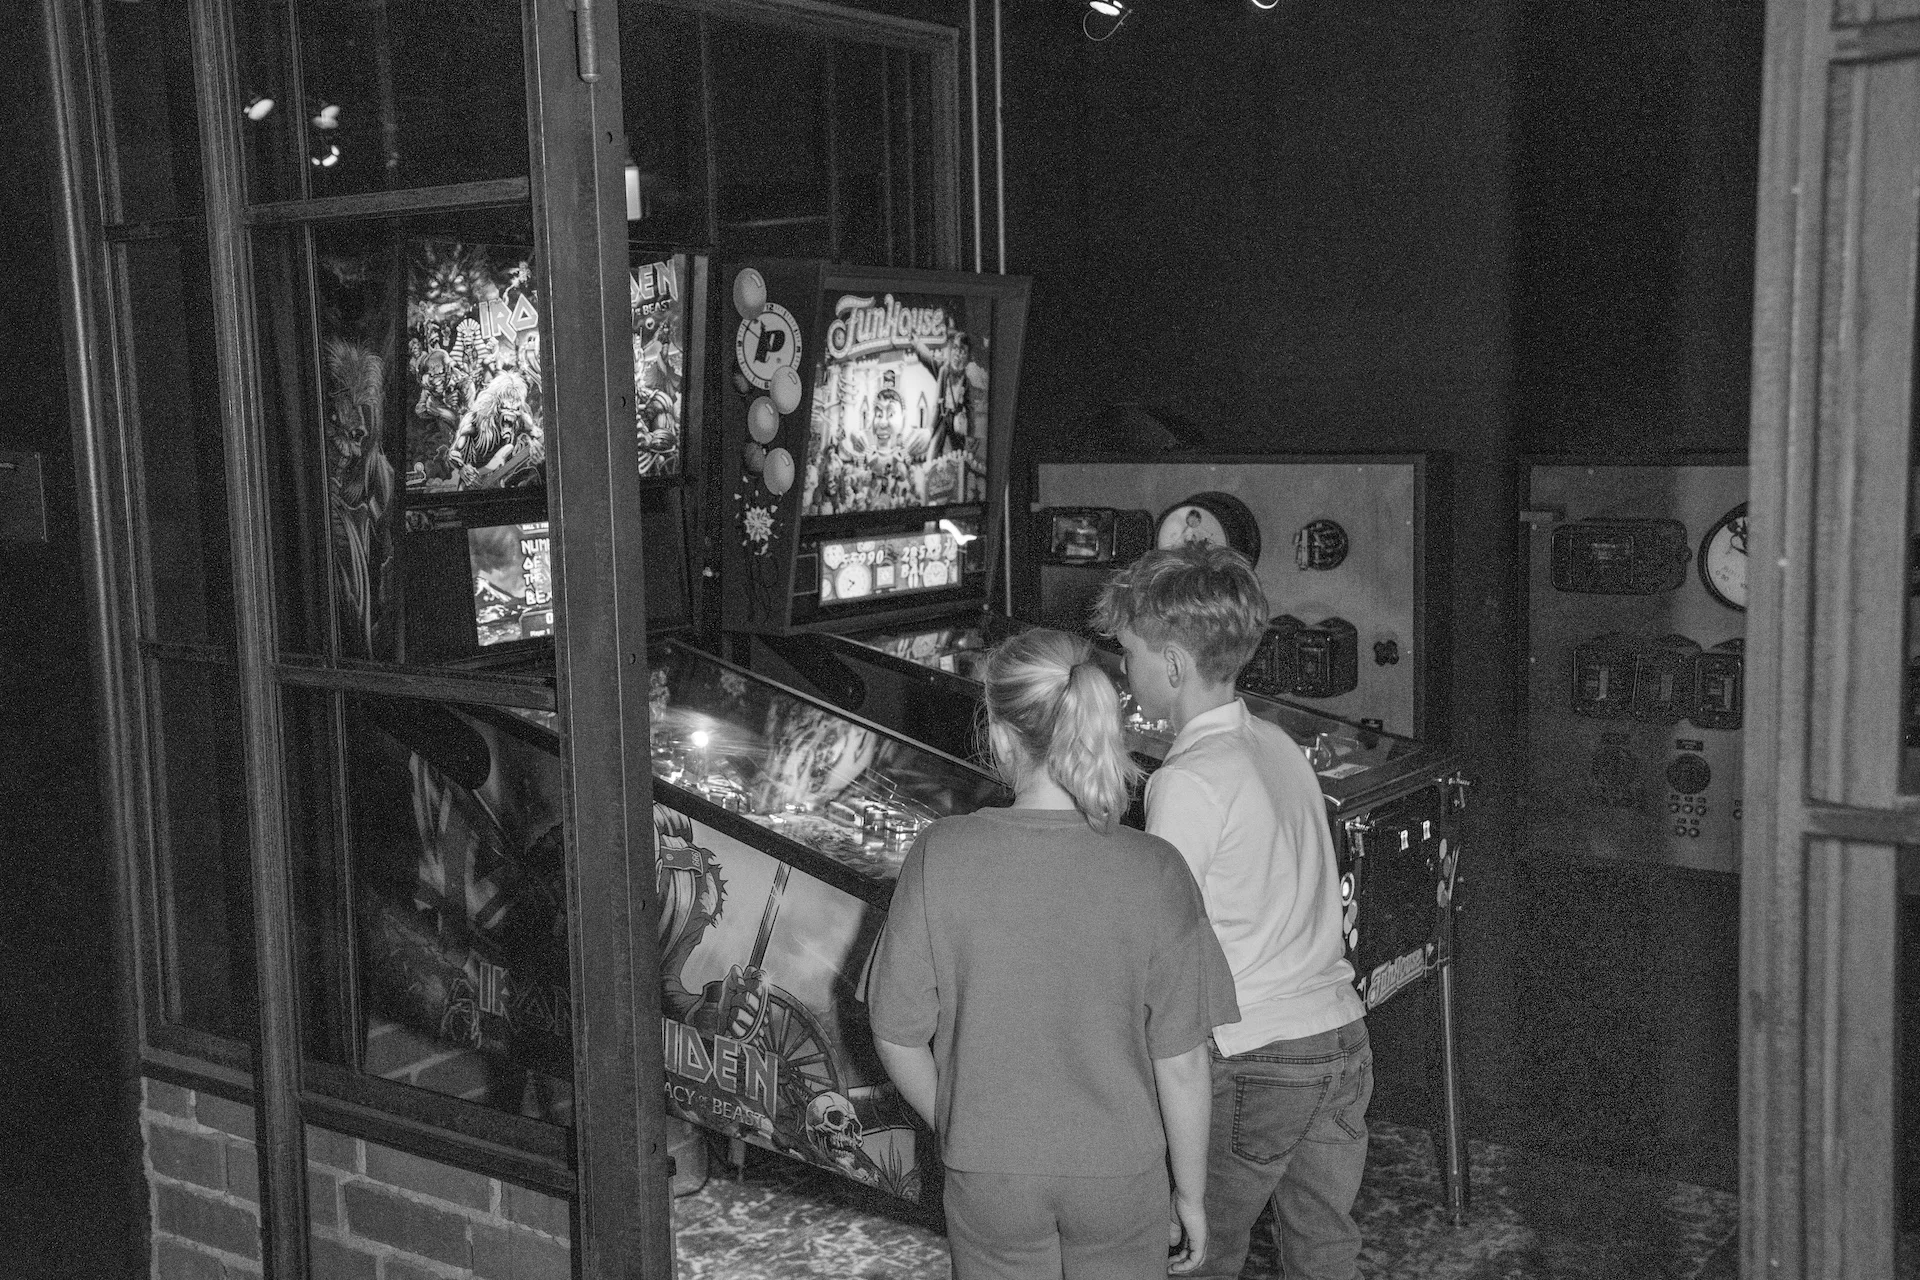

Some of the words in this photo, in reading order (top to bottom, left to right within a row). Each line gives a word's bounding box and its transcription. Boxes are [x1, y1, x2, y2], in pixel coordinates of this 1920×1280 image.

[479, 293, 539, 344] IRO
[521, 538, 550, 556] NUM
[662, 1017, 779, 1124] IDEN
[663, 1082, 696, 1106] ACY
[712, 1097, 766, 1130] BEAST
